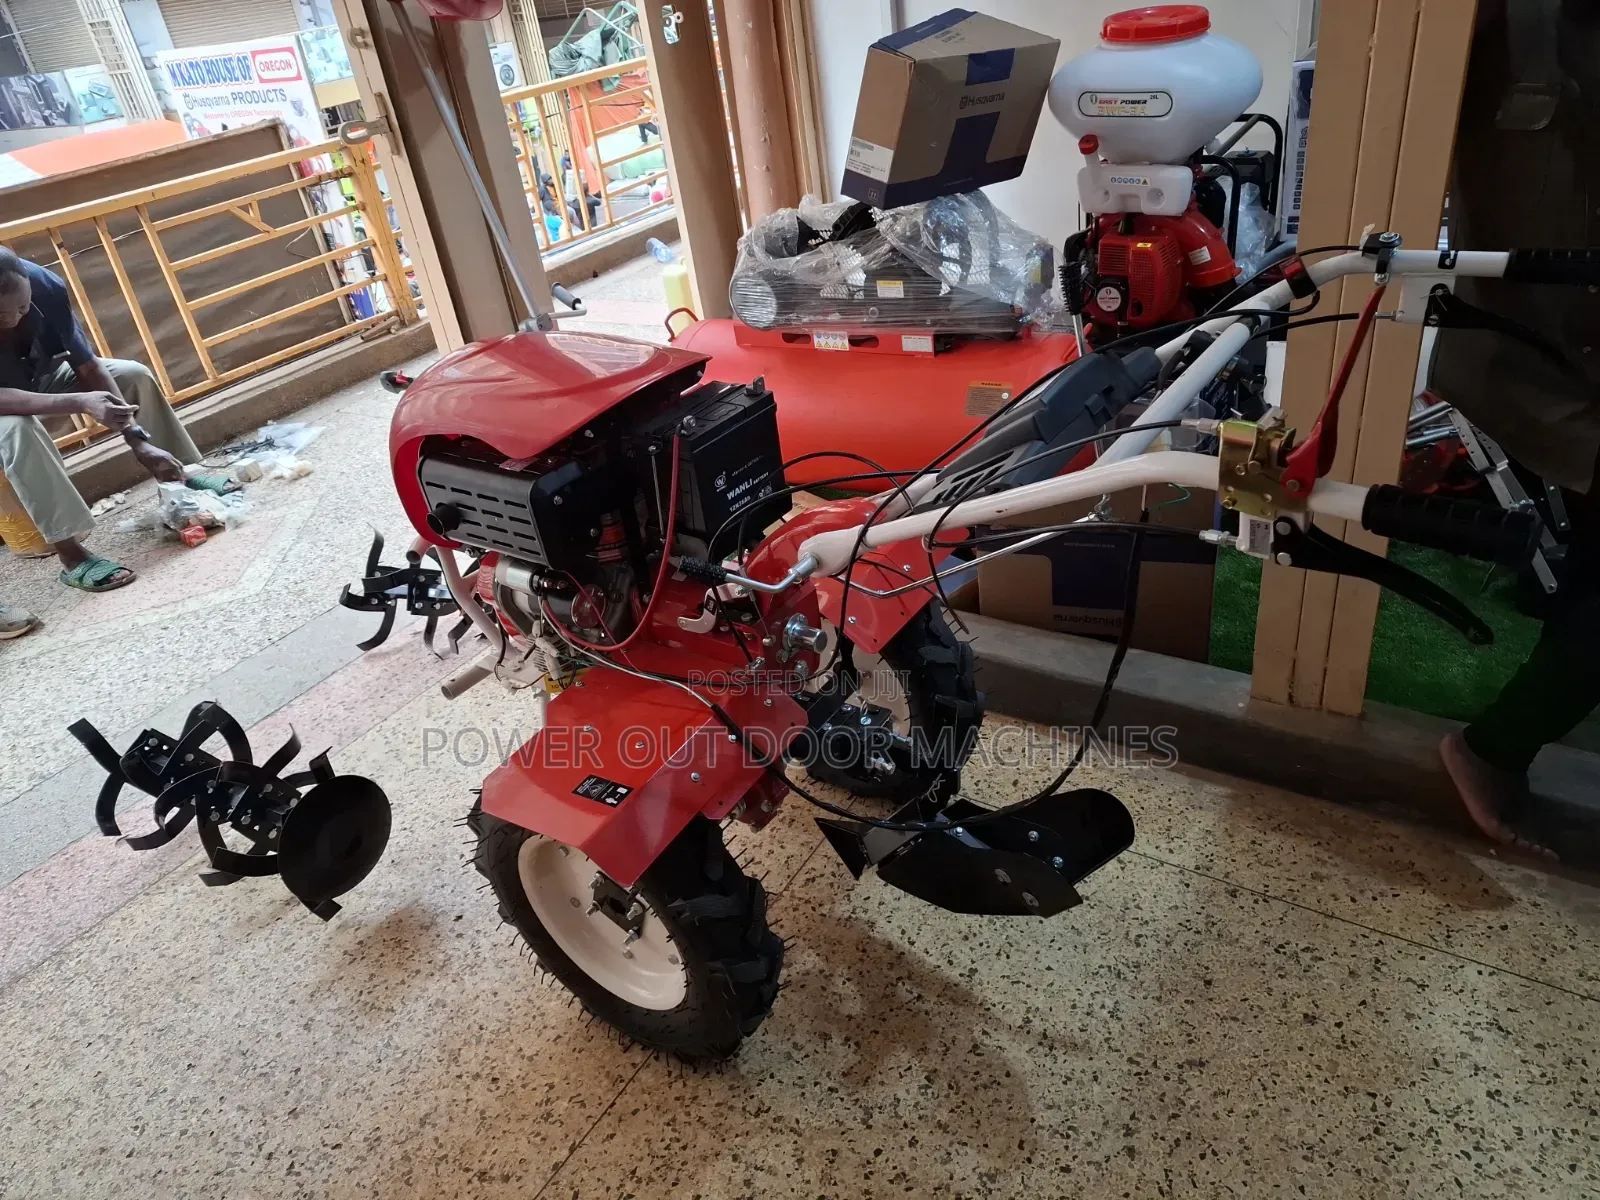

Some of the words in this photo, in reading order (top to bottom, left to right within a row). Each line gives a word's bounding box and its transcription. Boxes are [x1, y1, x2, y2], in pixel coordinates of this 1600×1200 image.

[202, 56, 239, 85] HOUSE
[236, 55, 252, 82] OF
[259, 60, 292, 72] OREGON
[231, 88, 287, 105] PRODUCTS
[727, 478, 753, 500] WANLI
